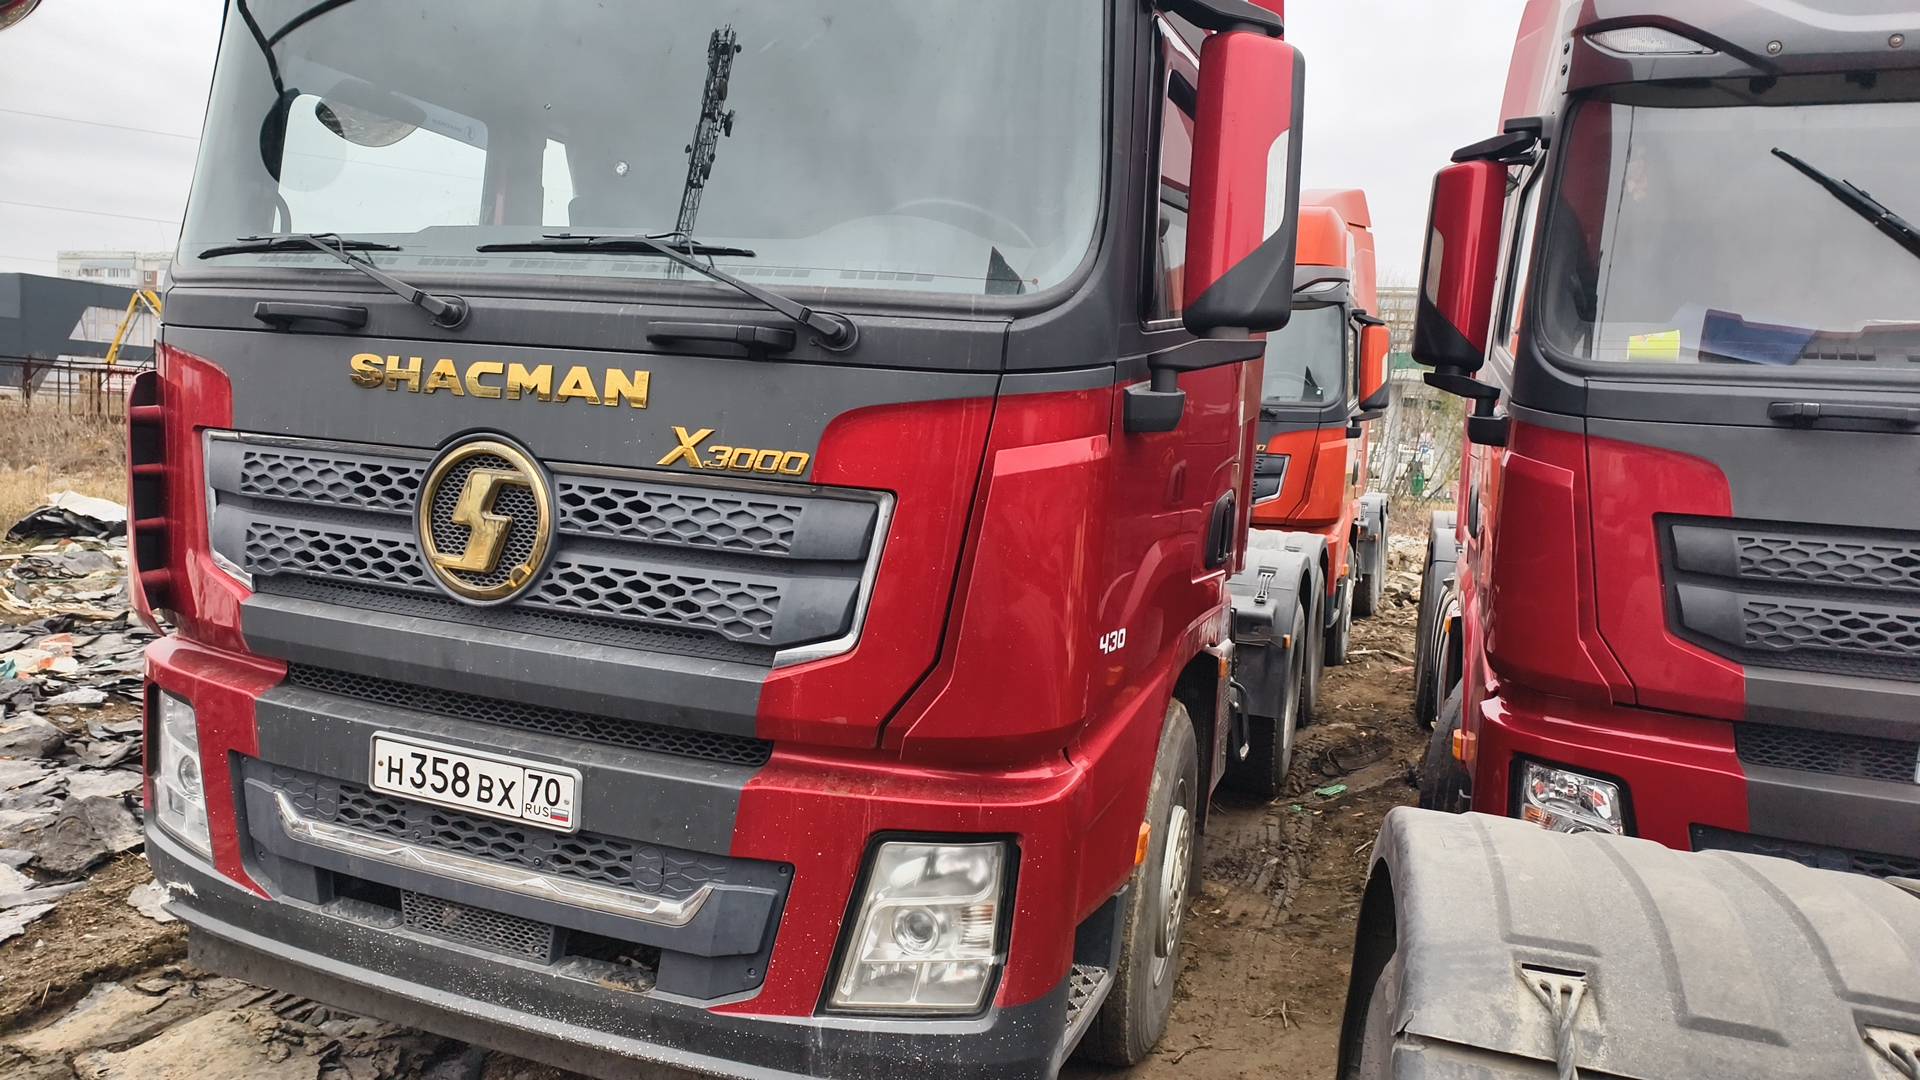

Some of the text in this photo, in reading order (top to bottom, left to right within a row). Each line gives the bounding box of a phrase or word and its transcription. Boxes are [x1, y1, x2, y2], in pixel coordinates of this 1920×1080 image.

[349, 352, 652, 409] SHACMAN
[656, 425, 810, 476] X3000
[1099, 628, 1126, 655] 430
[528, 774, 561, 807] 70
[525, 803, 549, 818] RUS
